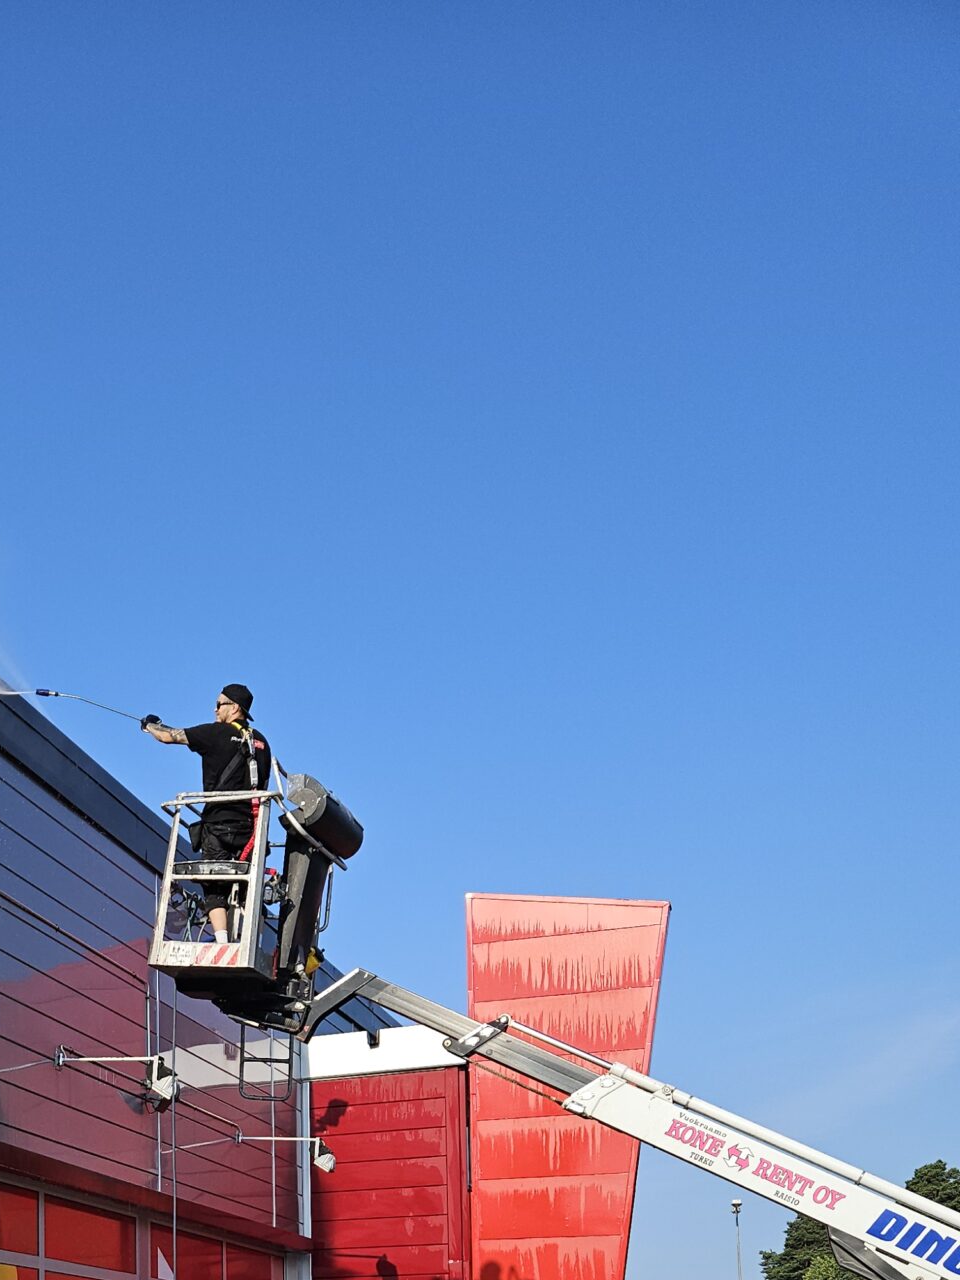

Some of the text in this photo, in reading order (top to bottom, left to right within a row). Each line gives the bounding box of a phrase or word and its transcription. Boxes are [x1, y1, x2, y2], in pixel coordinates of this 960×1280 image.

[679, 1111, 727, 1138] Vuokraamo
[664, 1119, 846, 1211] KONE RENT OY
[690, 1152, 715, 1166] TURKU
[774, 1190, 800, 1206] RAISIO
